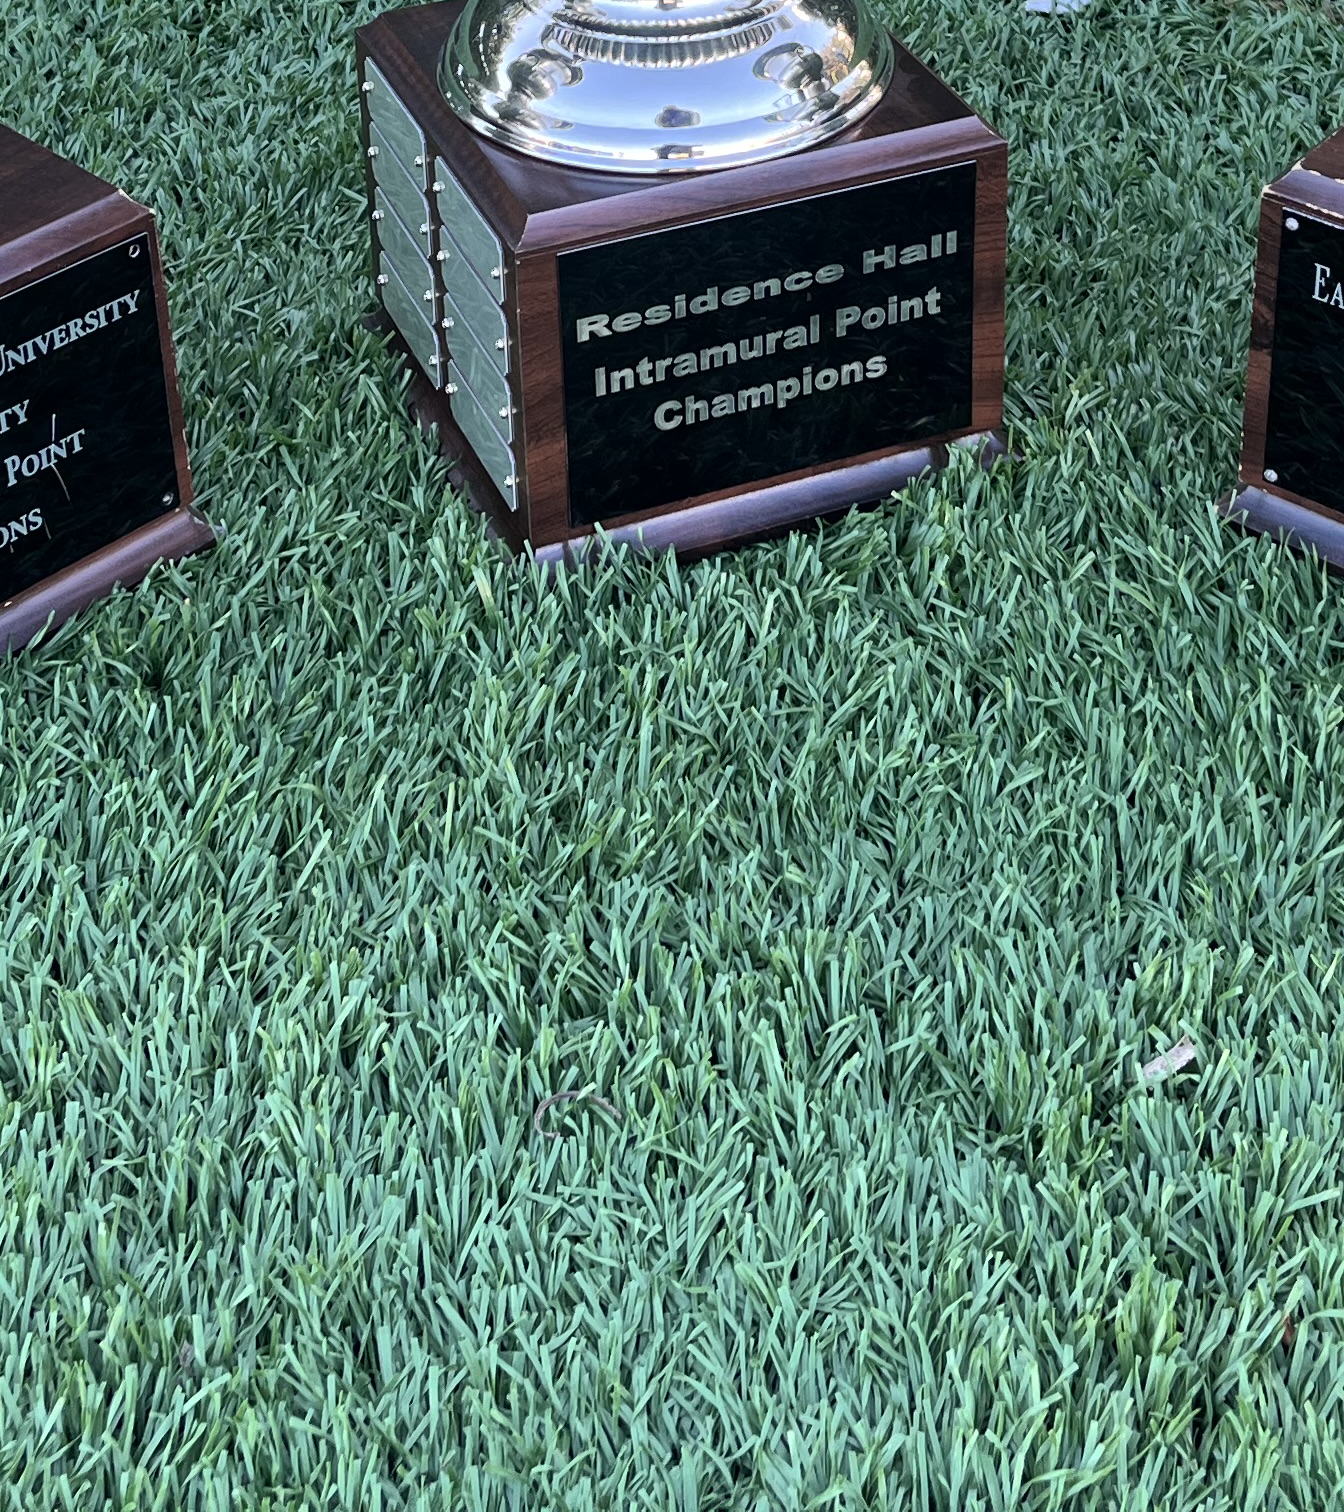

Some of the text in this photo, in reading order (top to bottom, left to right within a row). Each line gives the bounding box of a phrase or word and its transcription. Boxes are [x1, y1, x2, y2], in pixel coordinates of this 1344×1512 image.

[576, 230, 957, 343] Residence Hall
[594, 286, 941, 397] Intramural Point
[654, 355, 888, 431] Champions
